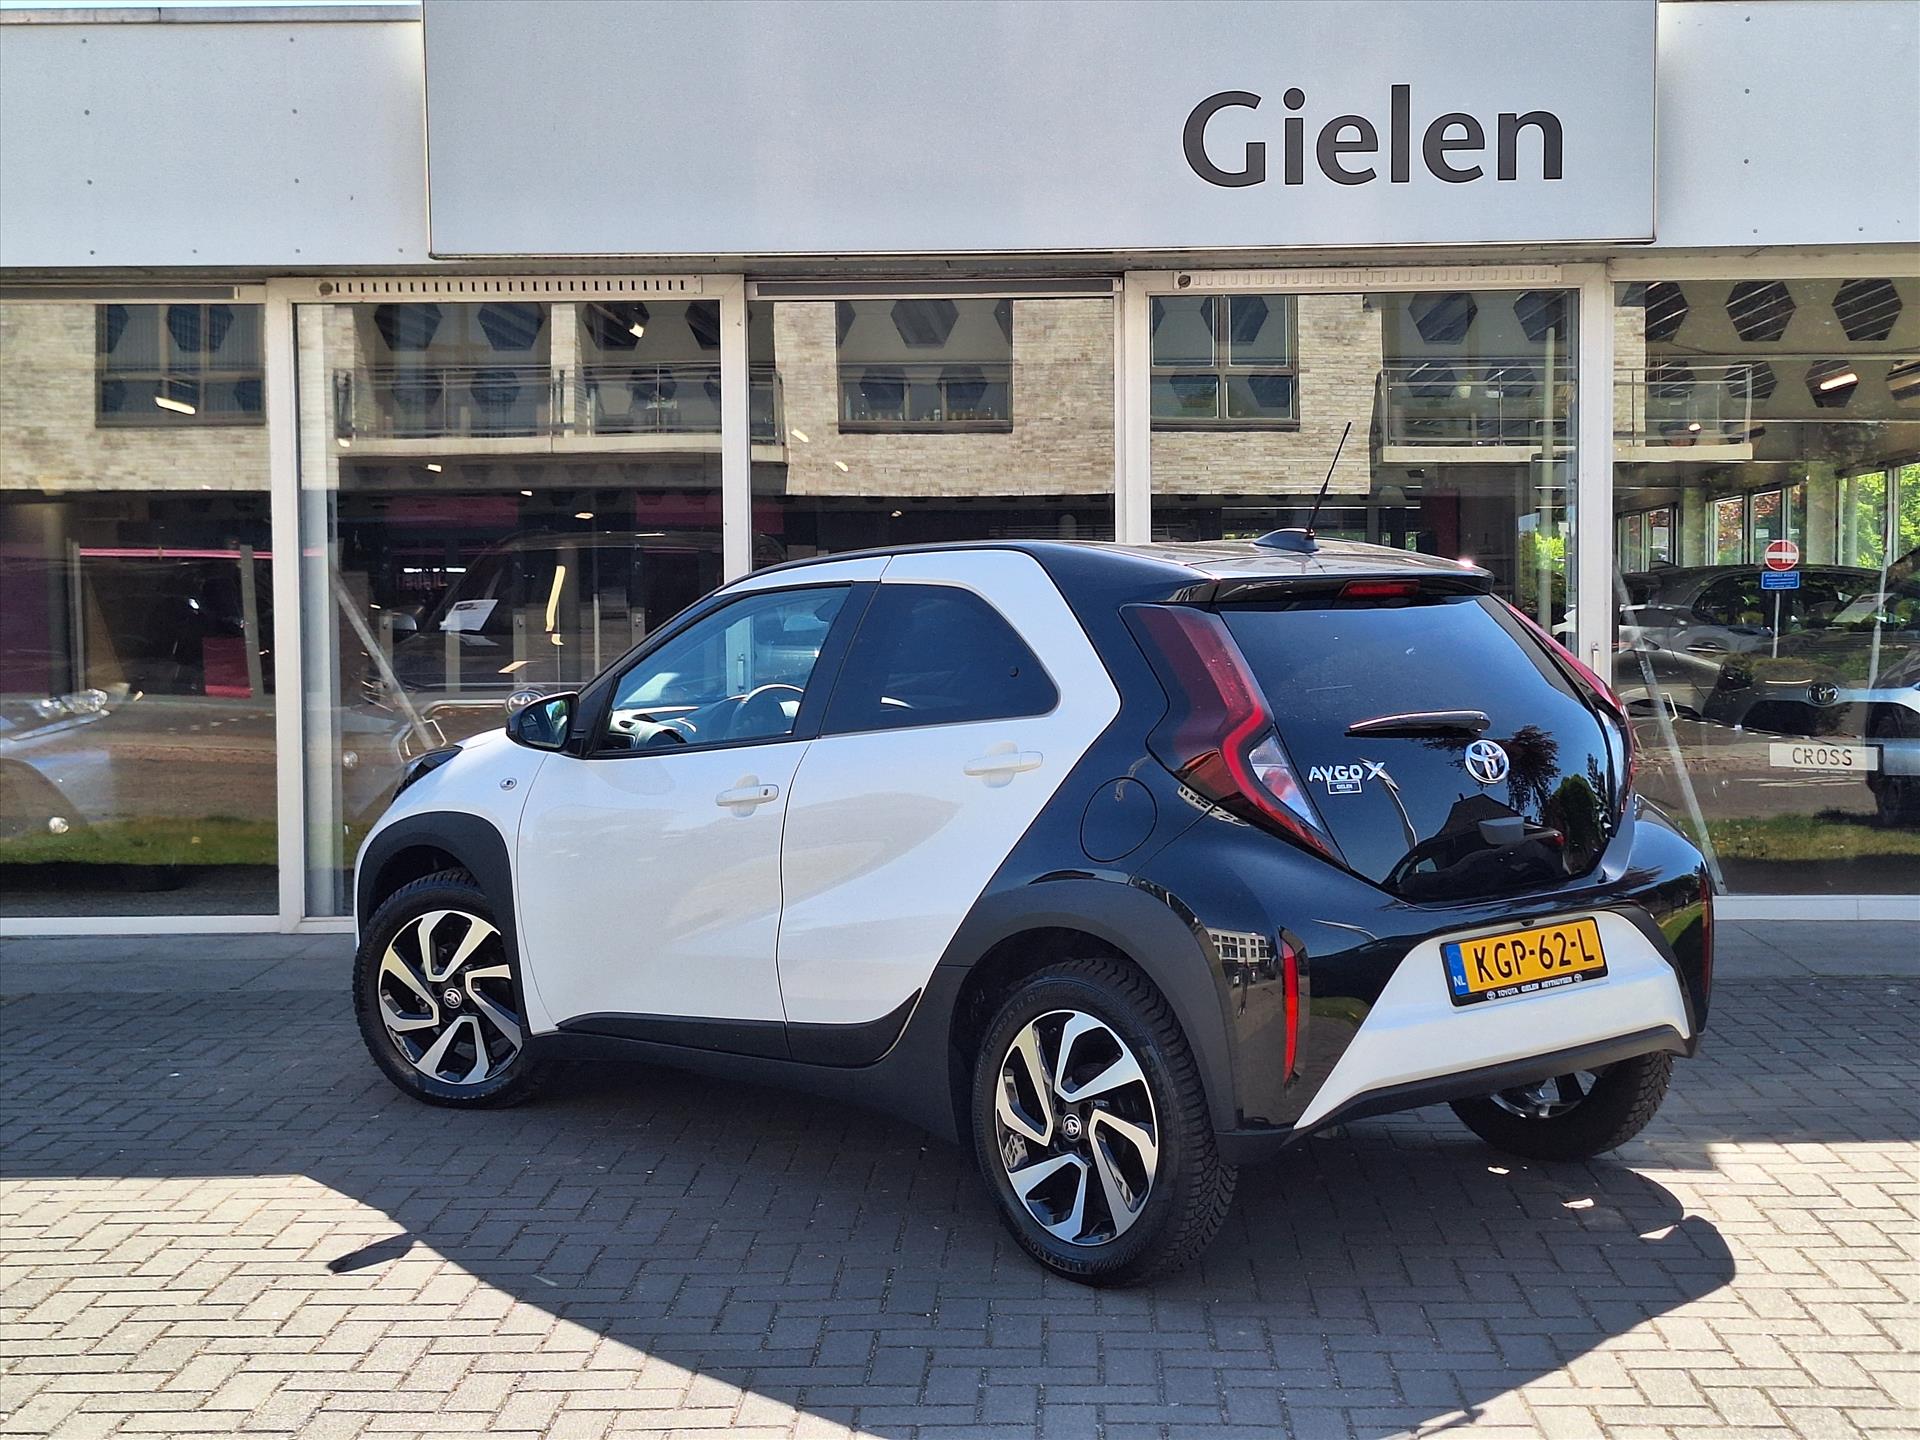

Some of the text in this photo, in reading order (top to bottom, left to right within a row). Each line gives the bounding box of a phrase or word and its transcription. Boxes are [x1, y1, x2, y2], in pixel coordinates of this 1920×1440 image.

[1183, 84, 1563, 188] Gielen
[1792, 747, 1852, 767] CROSS
[1308, 764, 1363, 781] AYGO
[1453, 928, 1595, 986] NL KGP-62-L
[1497, 987, 1519, 997] TOYOTA
